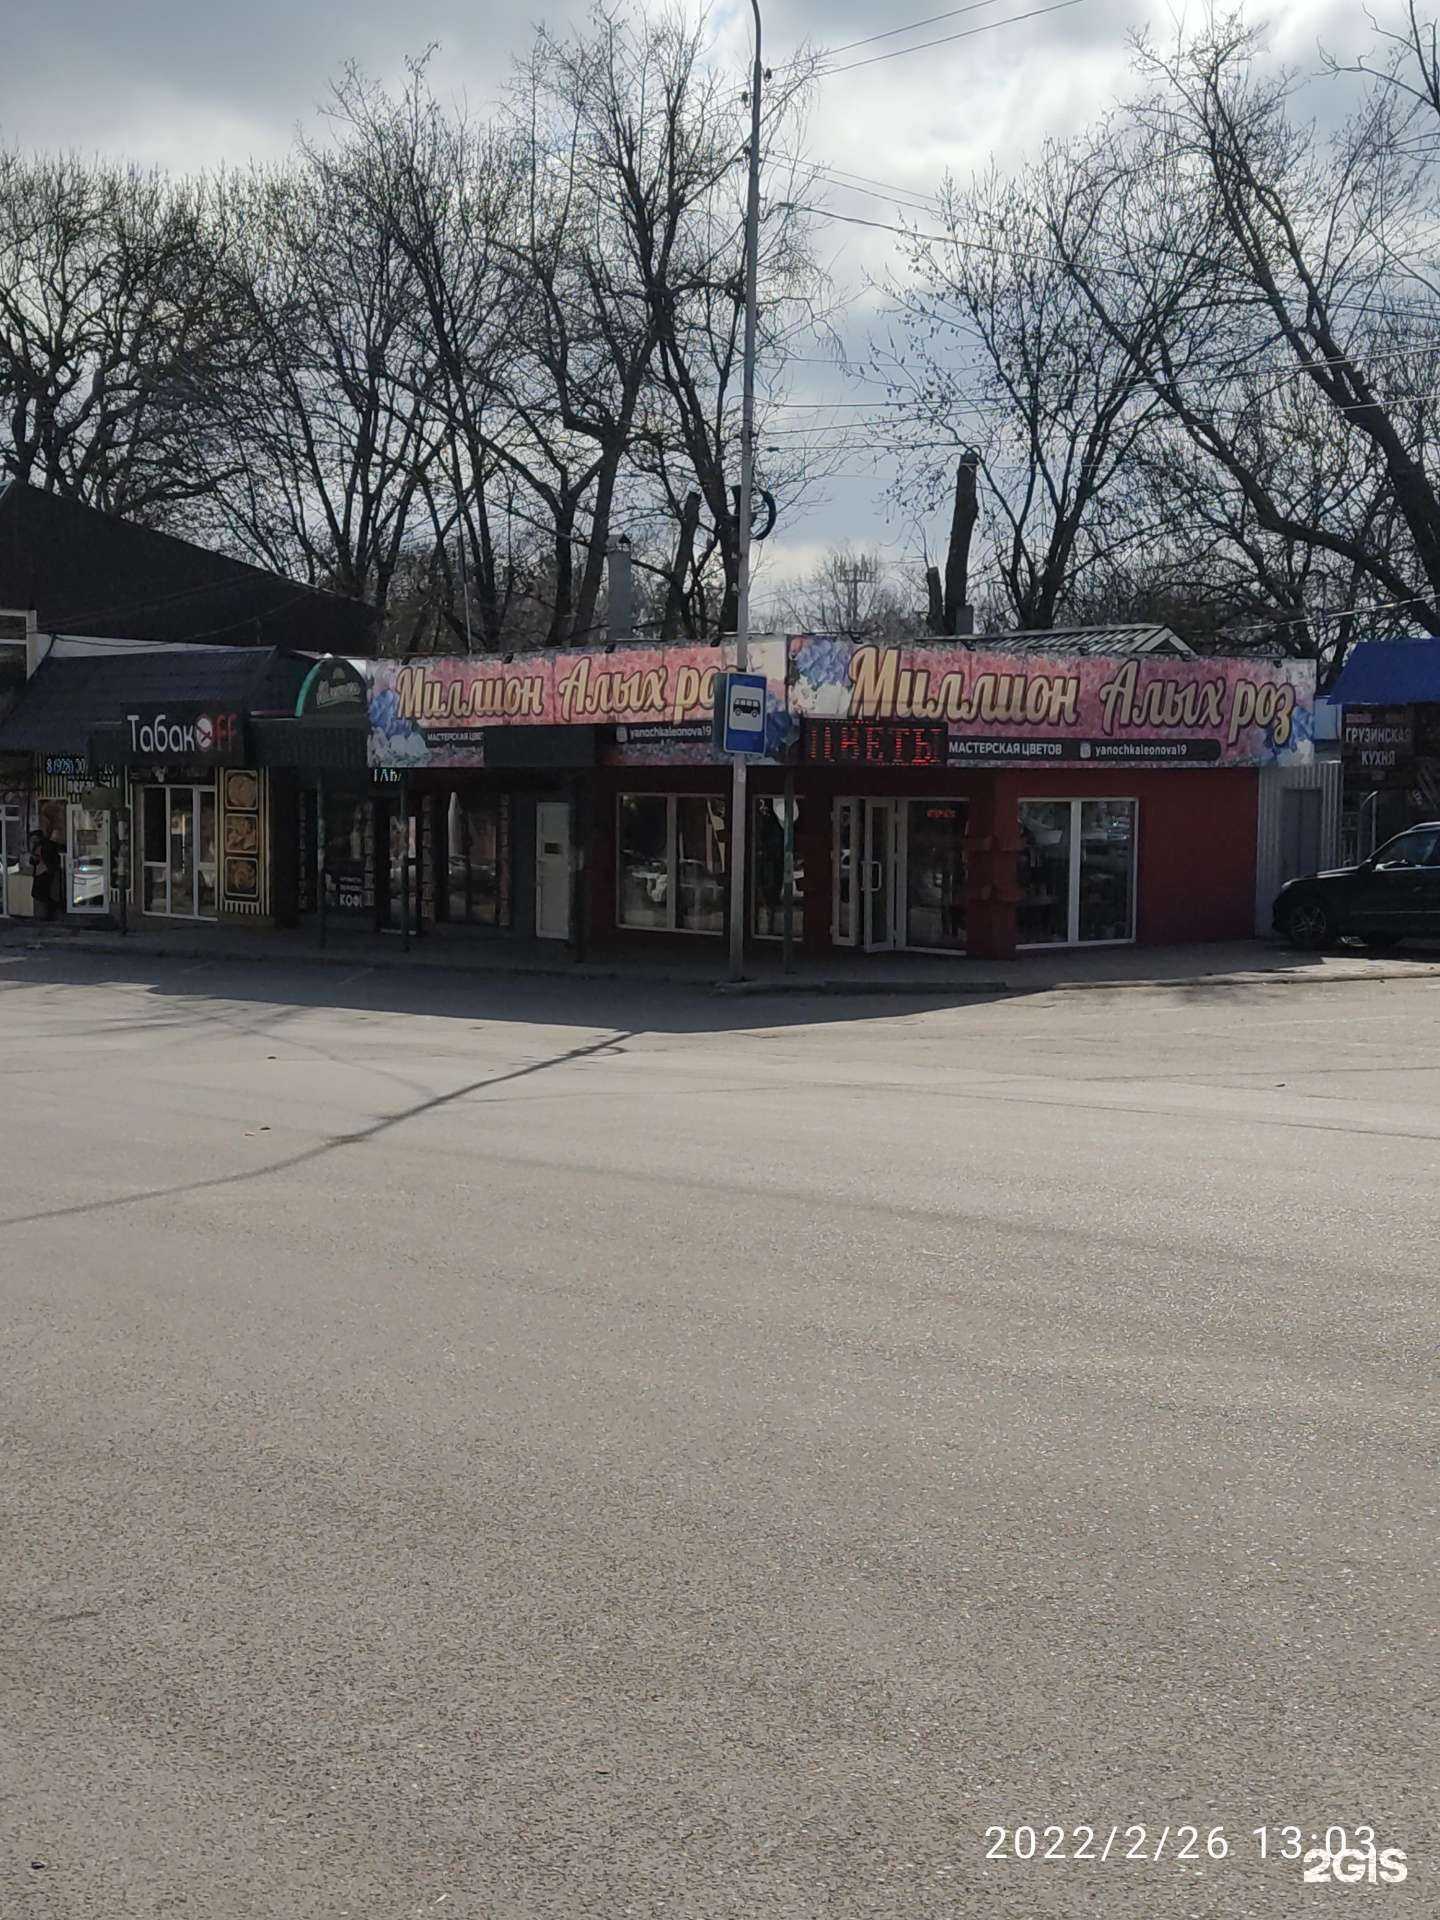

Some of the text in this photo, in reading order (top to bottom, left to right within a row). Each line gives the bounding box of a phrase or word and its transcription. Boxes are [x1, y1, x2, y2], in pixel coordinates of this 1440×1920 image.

[395, 665, 544, 720] Миллион
[559, 657, 667, 723] Алых
[673, 664, 736, 728] ро
[847, 645, 1298, 746] Миллион Алых роз
[1345, 727, 1413, 745] ГРУЗИНСКАЯ
[948, 741, 1063, 757] МАСТЕРСКАЯ ЦВЕТОВ
[1095, 741, 1188, 757] yanochkaleonova19
[1360, 750, 1396, 767] КУХНЯ
